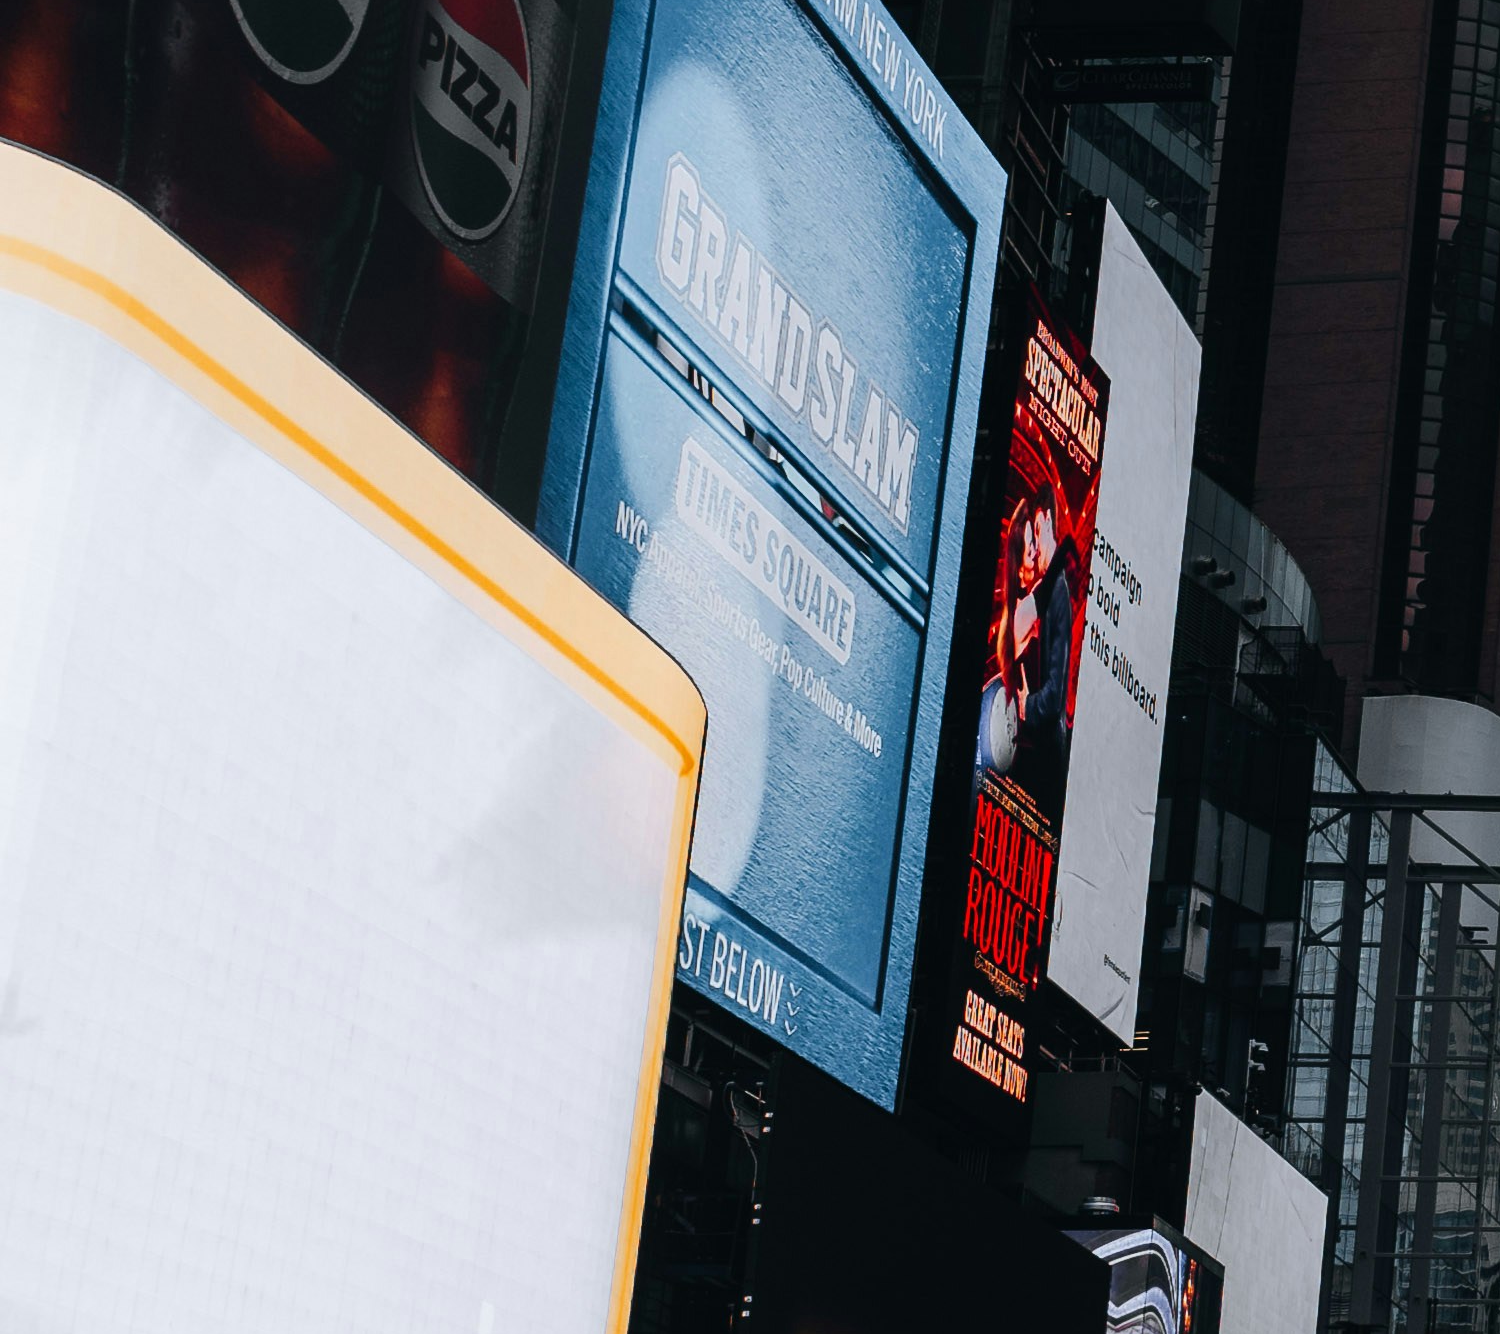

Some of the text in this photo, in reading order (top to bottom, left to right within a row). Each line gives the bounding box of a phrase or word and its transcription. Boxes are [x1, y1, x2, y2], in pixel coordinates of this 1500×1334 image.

[418, 13, 518, 164] PIZZA
[859, 2, 906, 92] NEW
[903, 64, 948, 158] YORK
[1025, 336, 1100, 463] SPECTACULAR
[1029, 392, 1068, 446] NIGHT
[682, 450, 852, 650] TIMES SQUARE
[1096, 576, 1121, 628] bold
[615, 501, 648, 553] NYC
[749, 618, 779, 675] Gear,
[780, 642, 802, 693] Pop
[803, 666, 844, 724] Culture
[844, 703, 854, 734] &
[853, 711, 882, 758] More
[1090, 622, 1158, 725] this billboard.
[971, 792, 1040, 908] MOULIN
[709, 933, 784, 1025] BELOW
[964, 988, 1025, 1060] GREAT SEATS
[953, 1024, 1028, 1103] AVAILABLE NOW!
